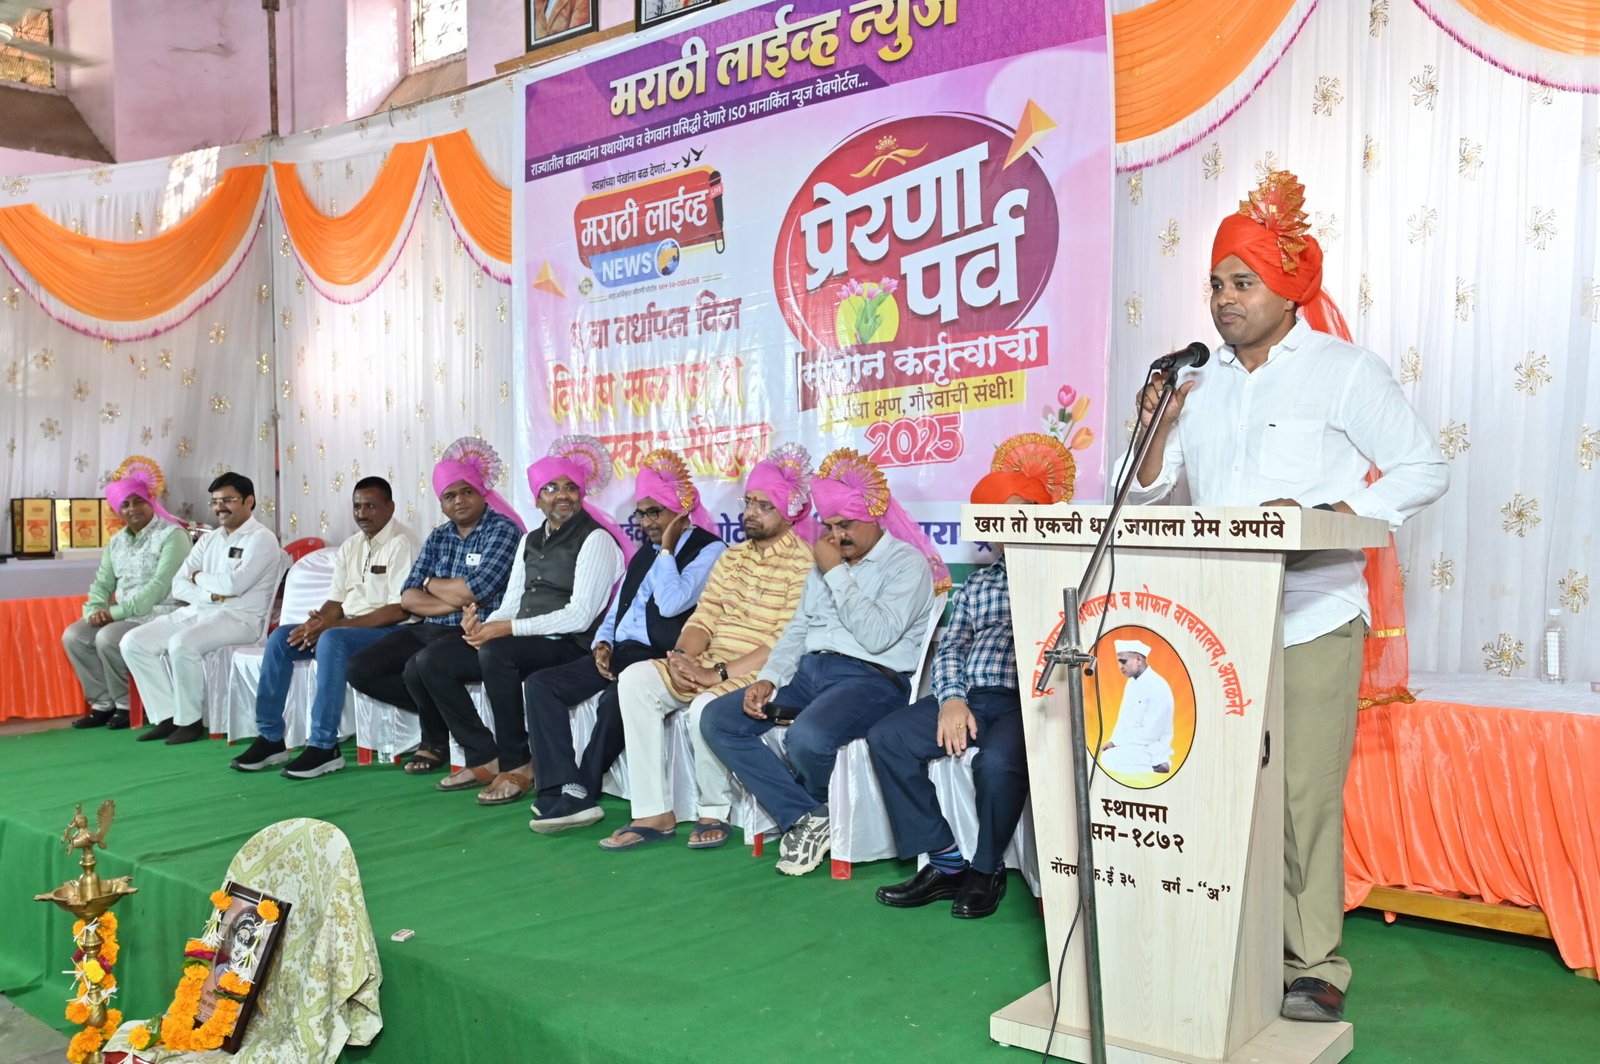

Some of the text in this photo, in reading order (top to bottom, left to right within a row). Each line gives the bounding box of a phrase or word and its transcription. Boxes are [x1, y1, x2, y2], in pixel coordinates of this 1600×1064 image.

[610, 36, 709, 117] मराठी
[716, 4, 841, 78] लाईव्ह
[600, 135, 635, 156] यथायोग्य
[636, 133, 643, 147] व
[644, 127, 671, 146] वेगवान
[703, 106, 727, 128] देणारे
[728, 105, 747, 122] ISO
[580, 186, 709, 247] मराठी लाईव्ह
[801, 141, 989, 292] प्रेरणा
[602, 251, 651, 282] NEWS
[900, 188, 1029, 323] पर्व
[974, 378, 1014, 403] संधी!
[864, 412, 965, 467] 2025
[974, 516, 1005, 533] खरा
[1011, 510, 1028, 533] तो
[1034, 511, 1083, 538] एकची
[1192, 511, 1220, 538] प्रेम
[1228, 506, 1286, 538] अर्पावे
[1120, 591, 1132, 608] व
[1135, 584, 1172, 618] मोफत
[1101, 798, 1168, 824] स्थापना
[1050, 856, 1078, 877] नोंदण
[1161, 877, 1181, 895] वर्ग
